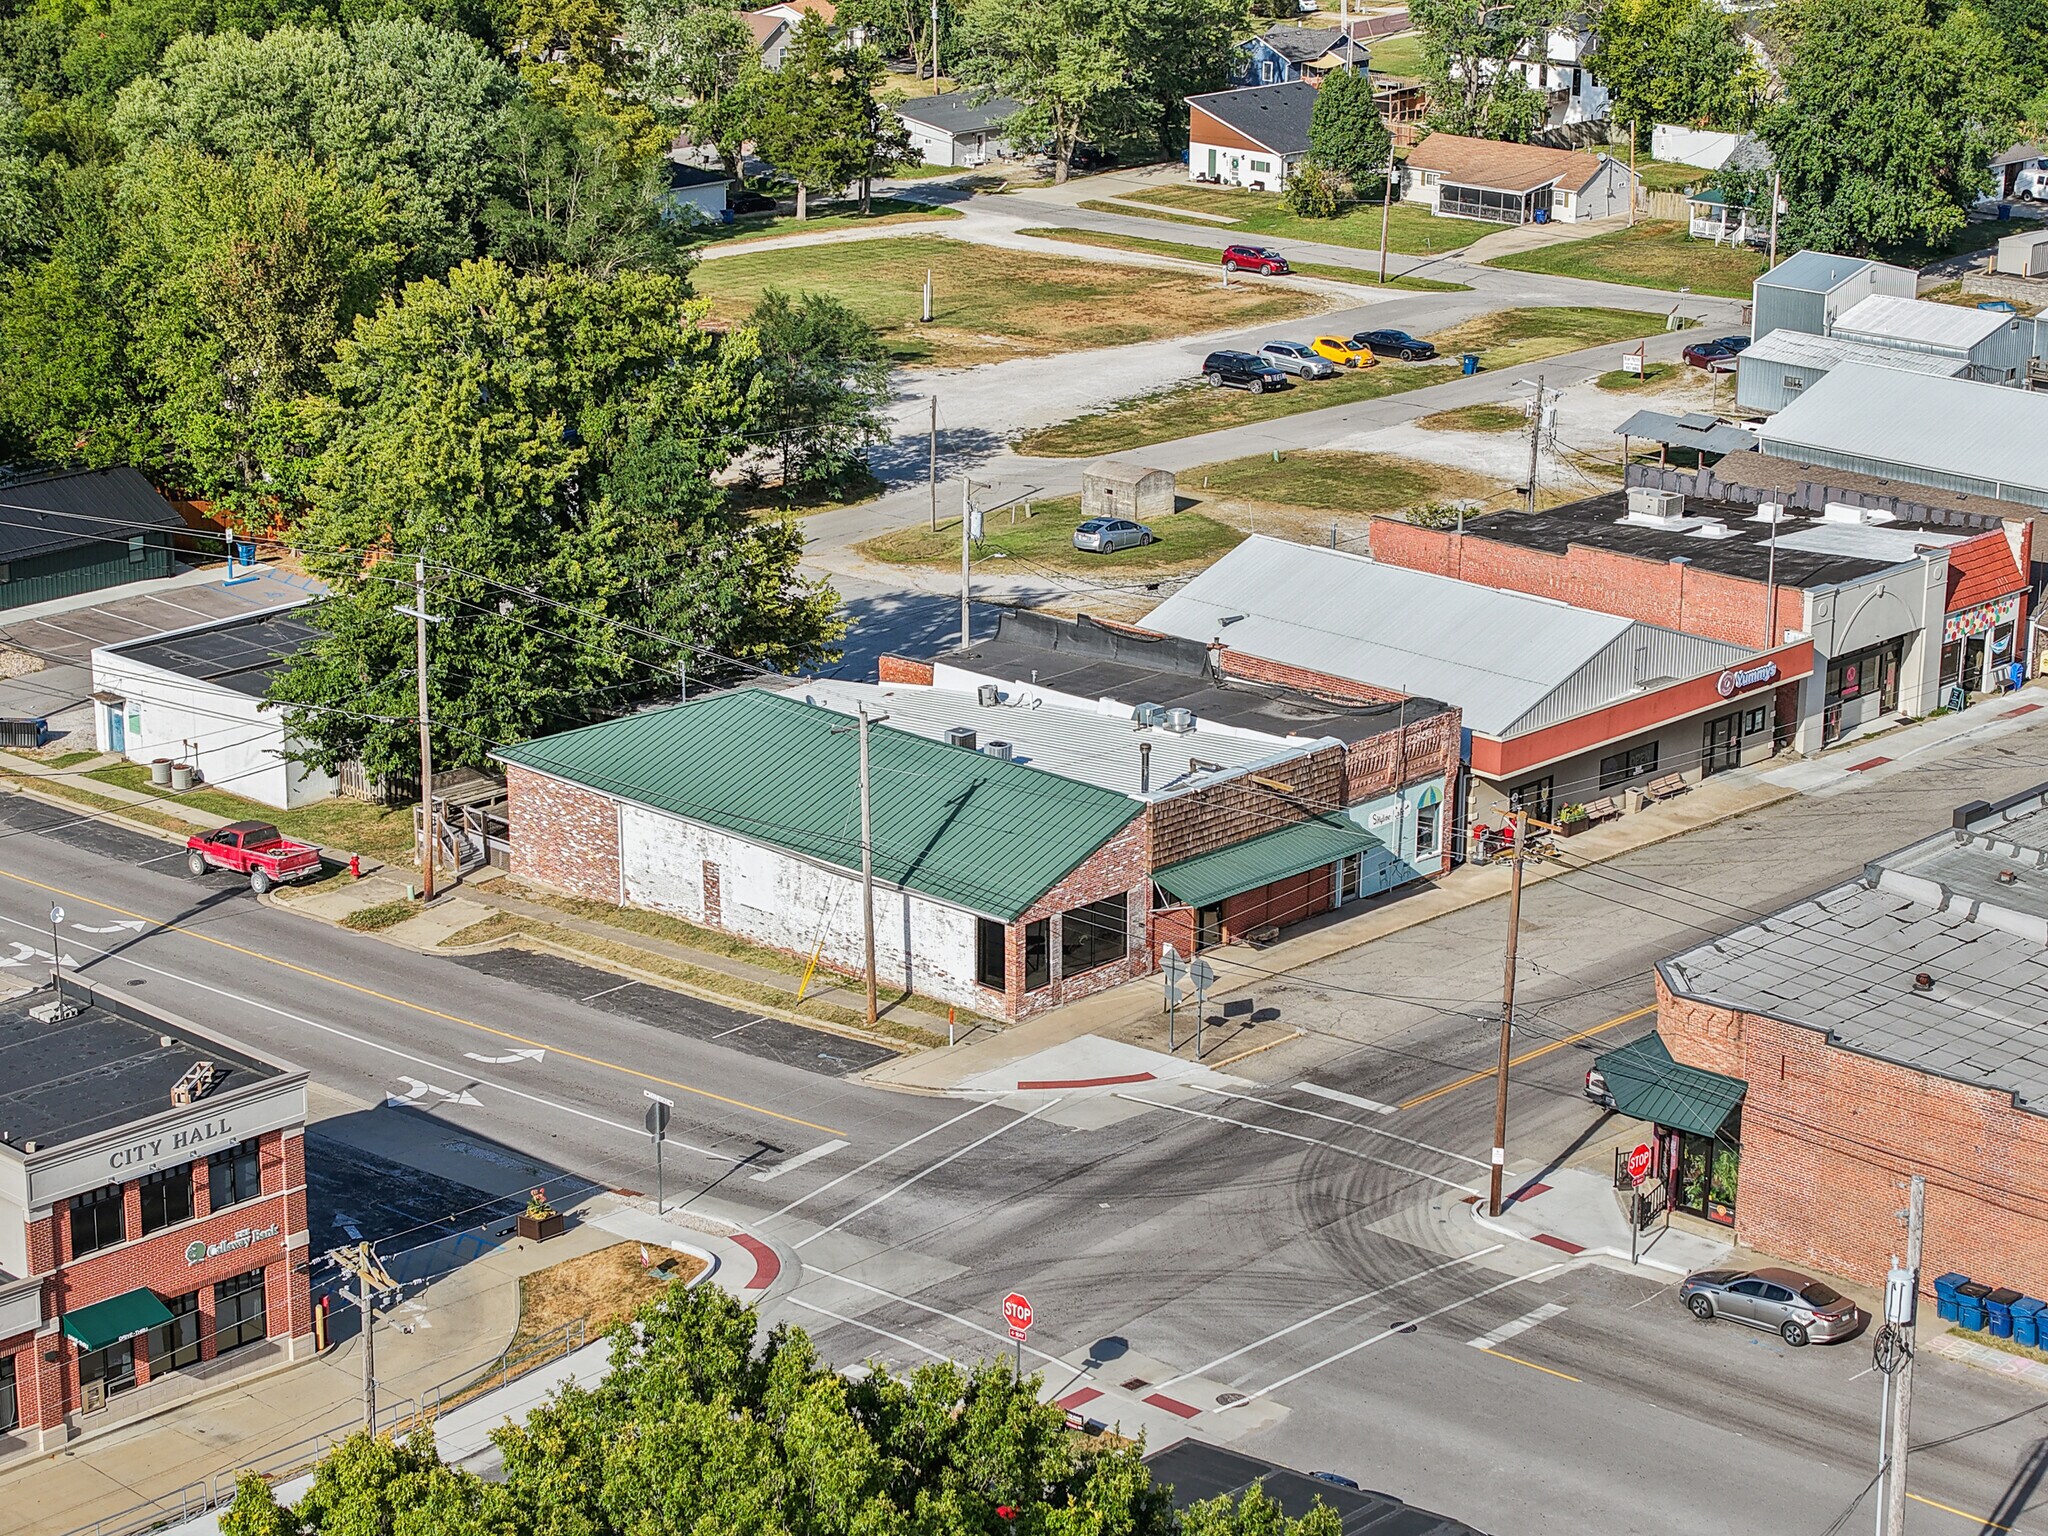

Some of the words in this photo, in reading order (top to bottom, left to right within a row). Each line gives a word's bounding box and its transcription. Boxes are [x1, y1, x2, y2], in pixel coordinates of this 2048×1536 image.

[109, 1139, 162, 1169] CITY
[172, 1118, 232, 1149] HALL
[1630, 1151, 1649, 1169] STOP
[207, 1237, 252, 1258] Callaway
[251, 1224, 279, 1243] Bank
[1005, 1302, 1031, 1321] STOP
